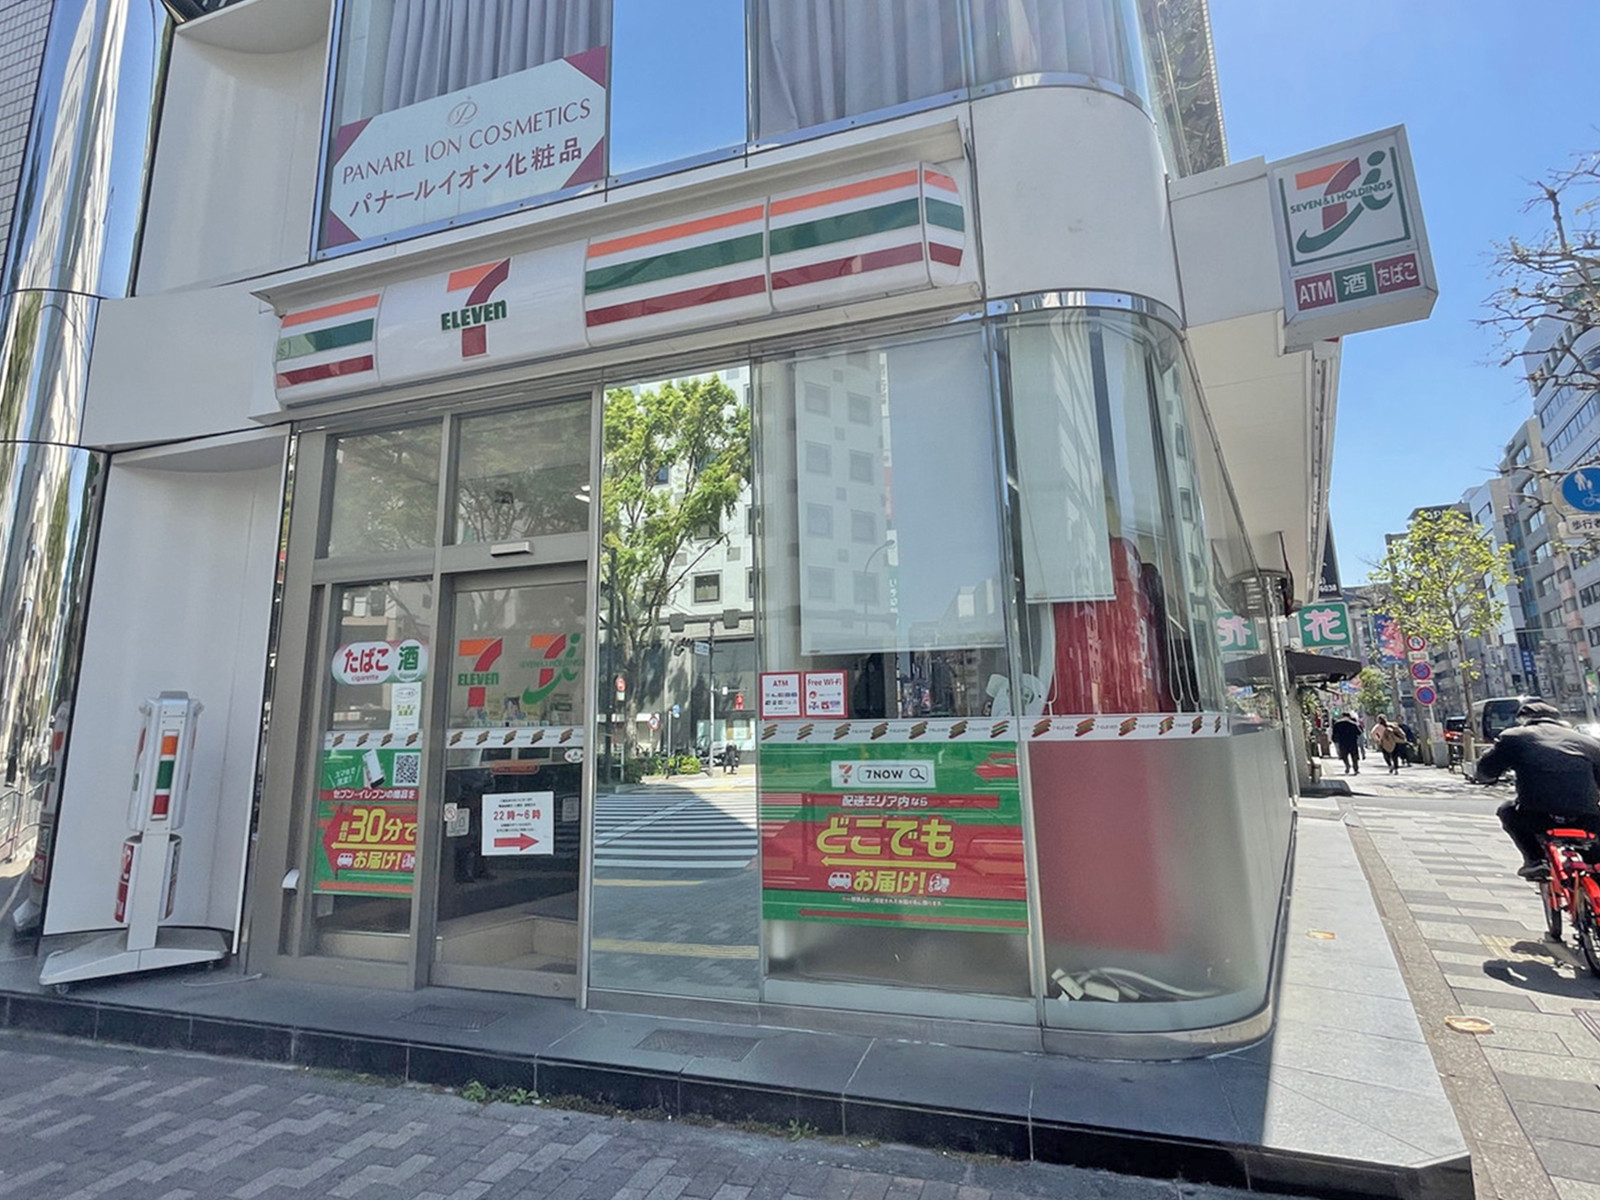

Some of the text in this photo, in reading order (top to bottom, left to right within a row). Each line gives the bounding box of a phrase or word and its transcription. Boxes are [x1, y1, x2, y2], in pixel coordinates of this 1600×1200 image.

[342, 98, 591, 184] PANARL ION COSMETICS
[349, 136, 582, 218] パナールイオン化粧品
[1336, 179, 1393, 201] HOLDINGS
[1342, 271, 1367, 296] 酒
[1377, 262, 1417, 287] たばこ
[1299, 279, 1333, 305] ATM
[1303, 608, 1347, 642] 花
[343, 647, 389, 674] たばこ
[397, 645, 420, 671] 酒
[772, 679, 789, 687] ATM
[807, 678, 842, 687] Free Wi-Fi
[865, 769, 903, 779] 7NOW
[842, 794, 928, 808] 配送エリア内なら
[816, 816, 955, 858] どこでも
[353, 850, 402, 870] お届け!
[852, 869, 927, 895] お届け!
